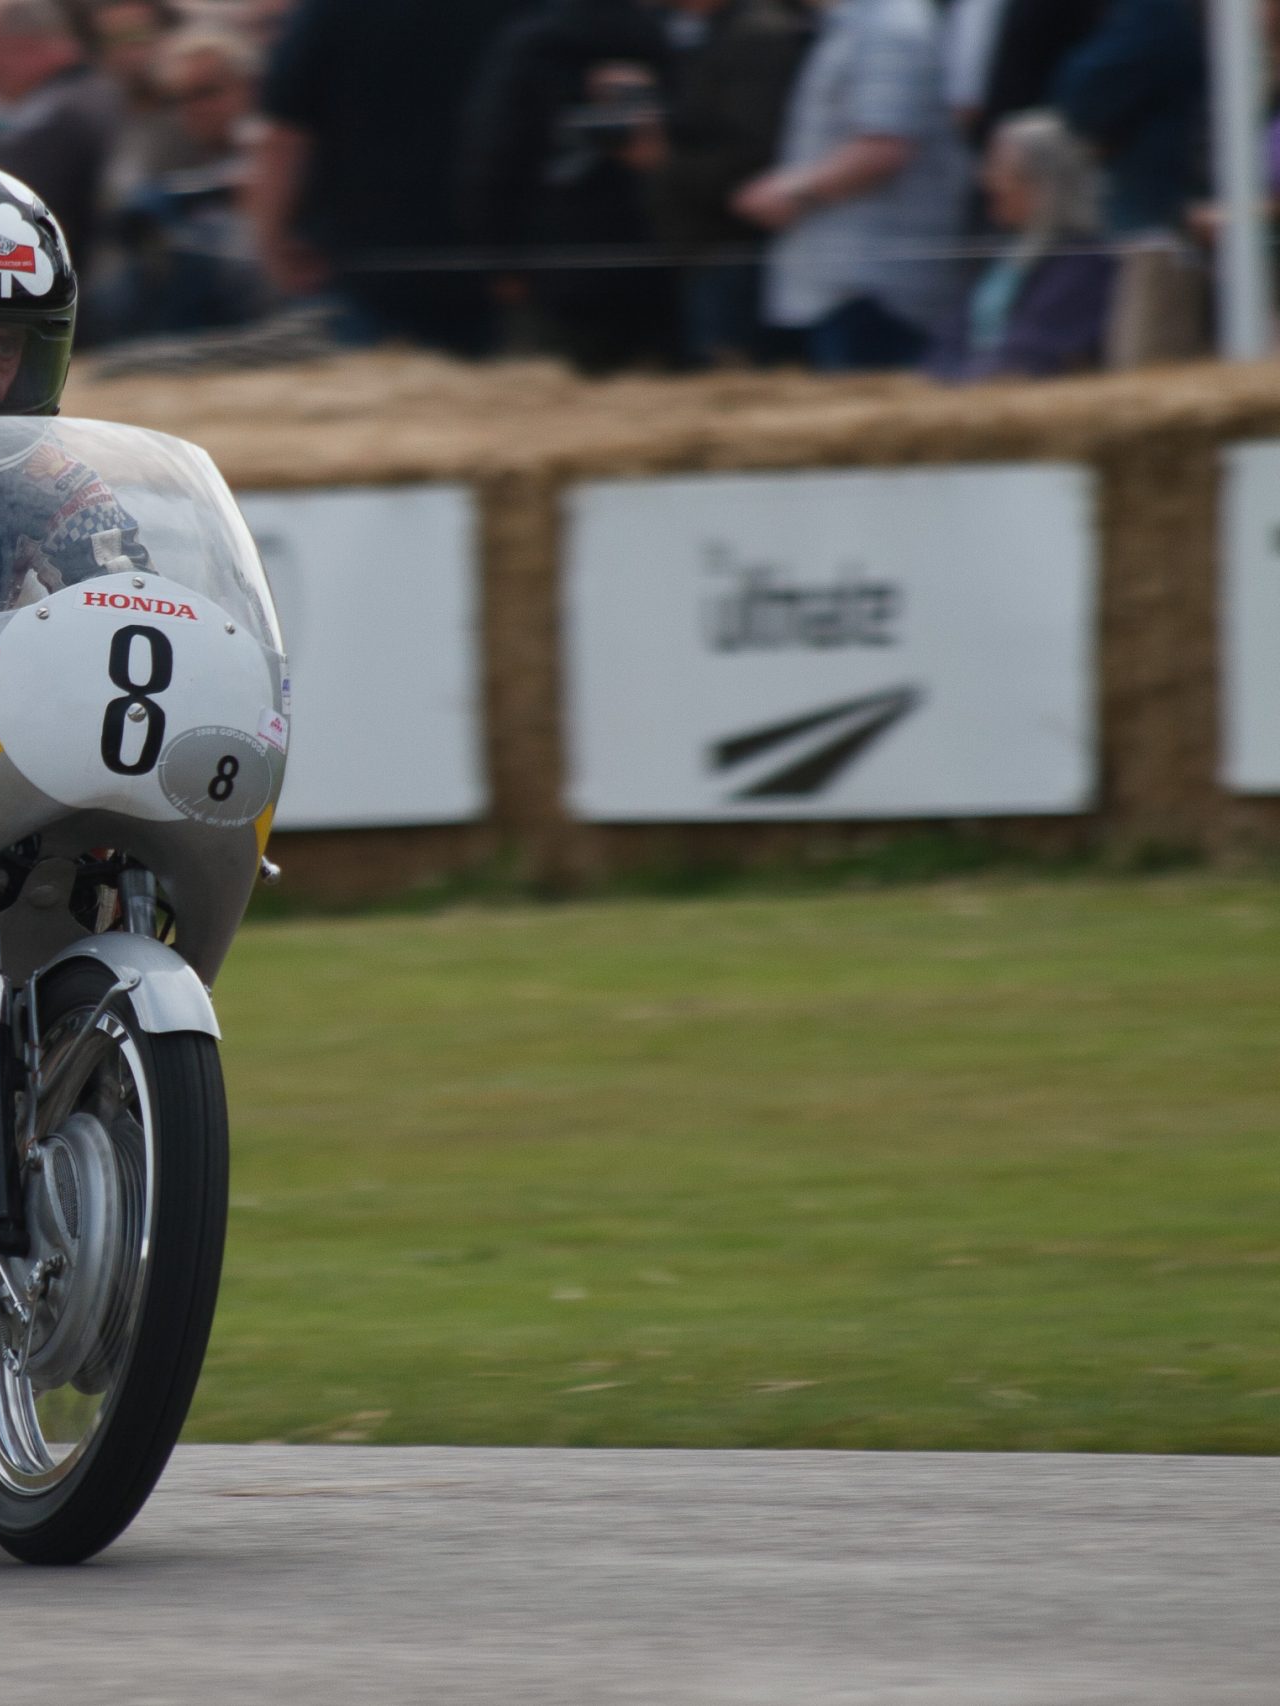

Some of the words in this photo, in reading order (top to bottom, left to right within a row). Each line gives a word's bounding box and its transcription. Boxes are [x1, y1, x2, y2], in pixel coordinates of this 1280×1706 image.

[82, 591, 199, 621] HONDA
[100, 624, 174, 776] 8
[219, 727, 267, 757] GOODWOOD
[208, 754, 240, 802] 8
